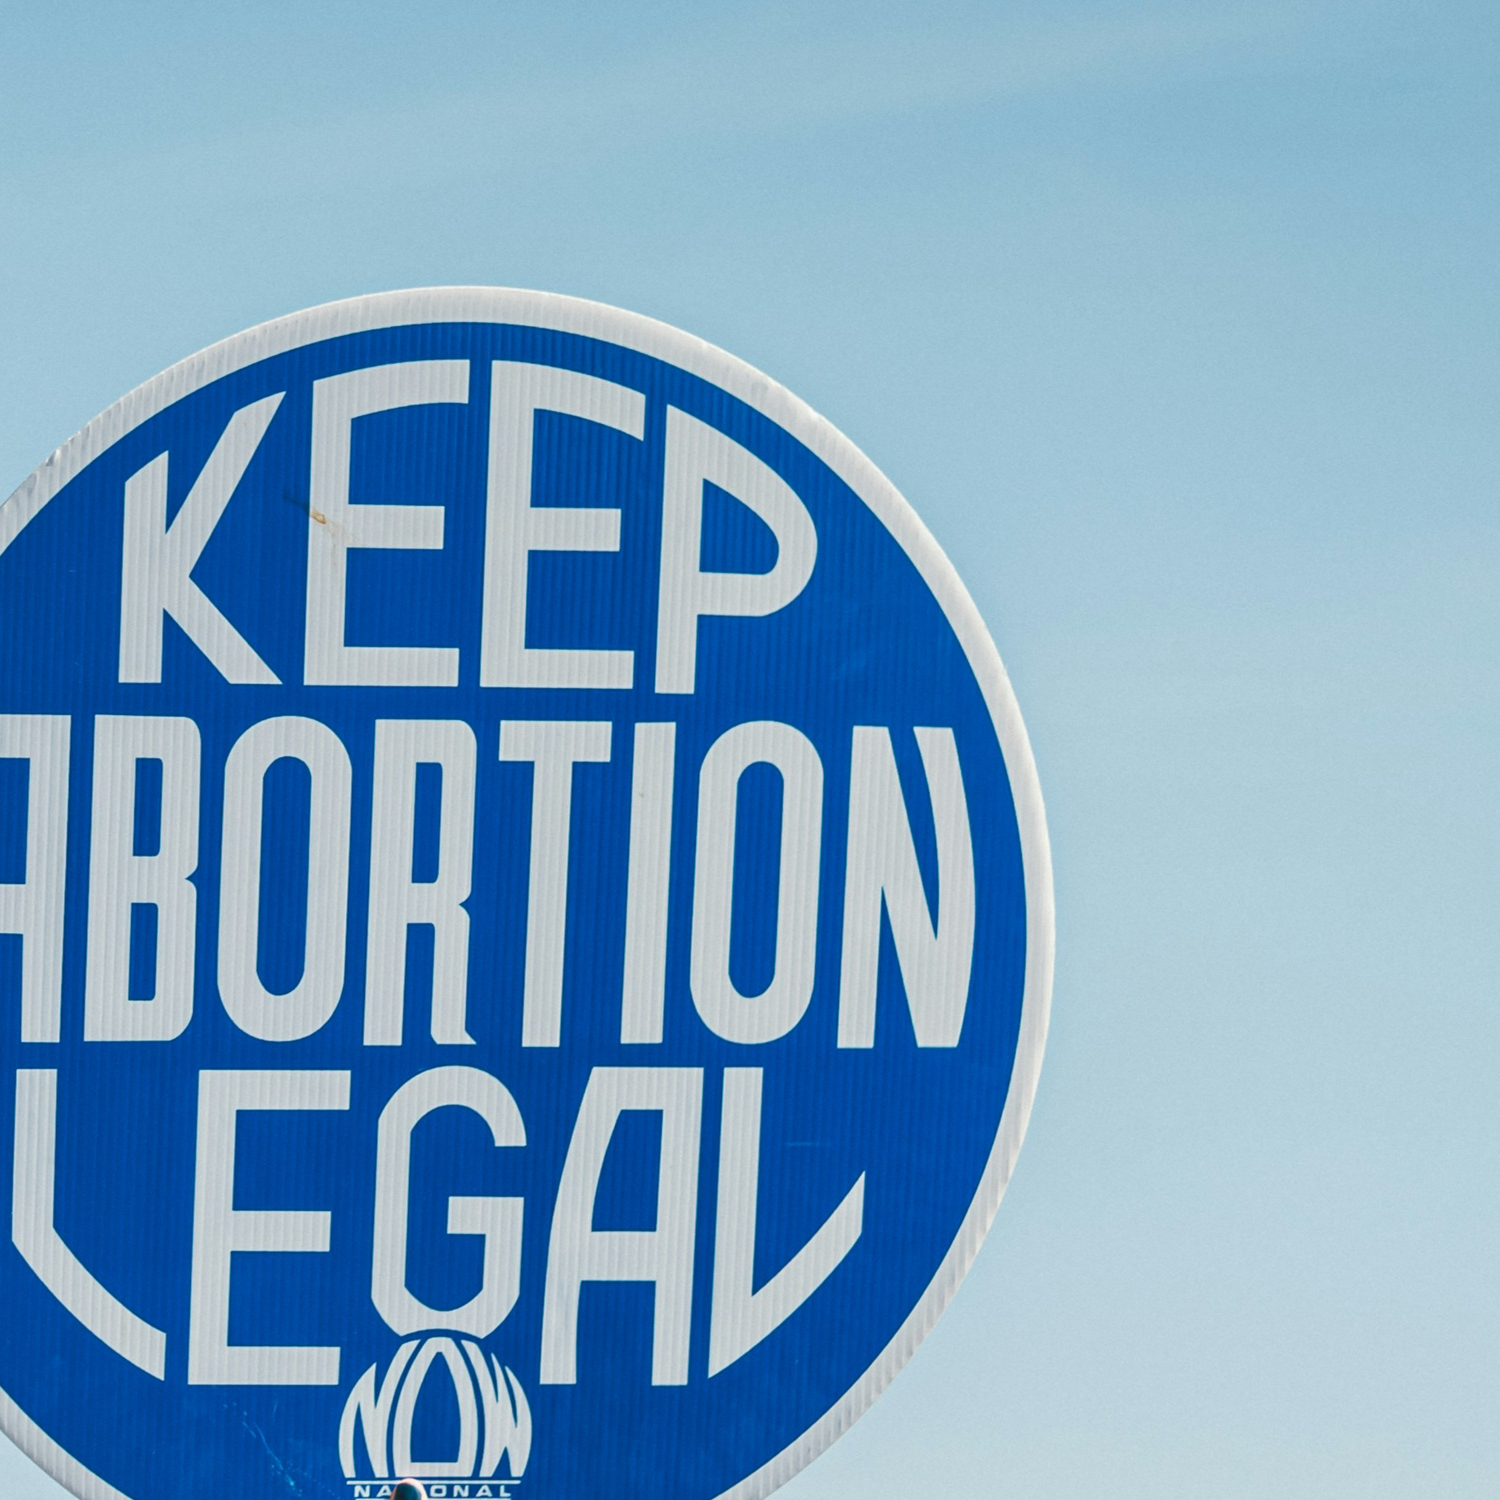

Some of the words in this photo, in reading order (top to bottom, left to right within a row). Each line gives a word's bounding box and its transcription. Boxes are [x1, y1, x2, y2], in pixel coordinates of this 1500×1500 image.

[119, 359, 818, 694] KEEP
[11, 1065, 866, 1386] LEGAL
[338, 1336, 533, 1478] NOW
[354, 1485, 511, 1498] NAONAL
